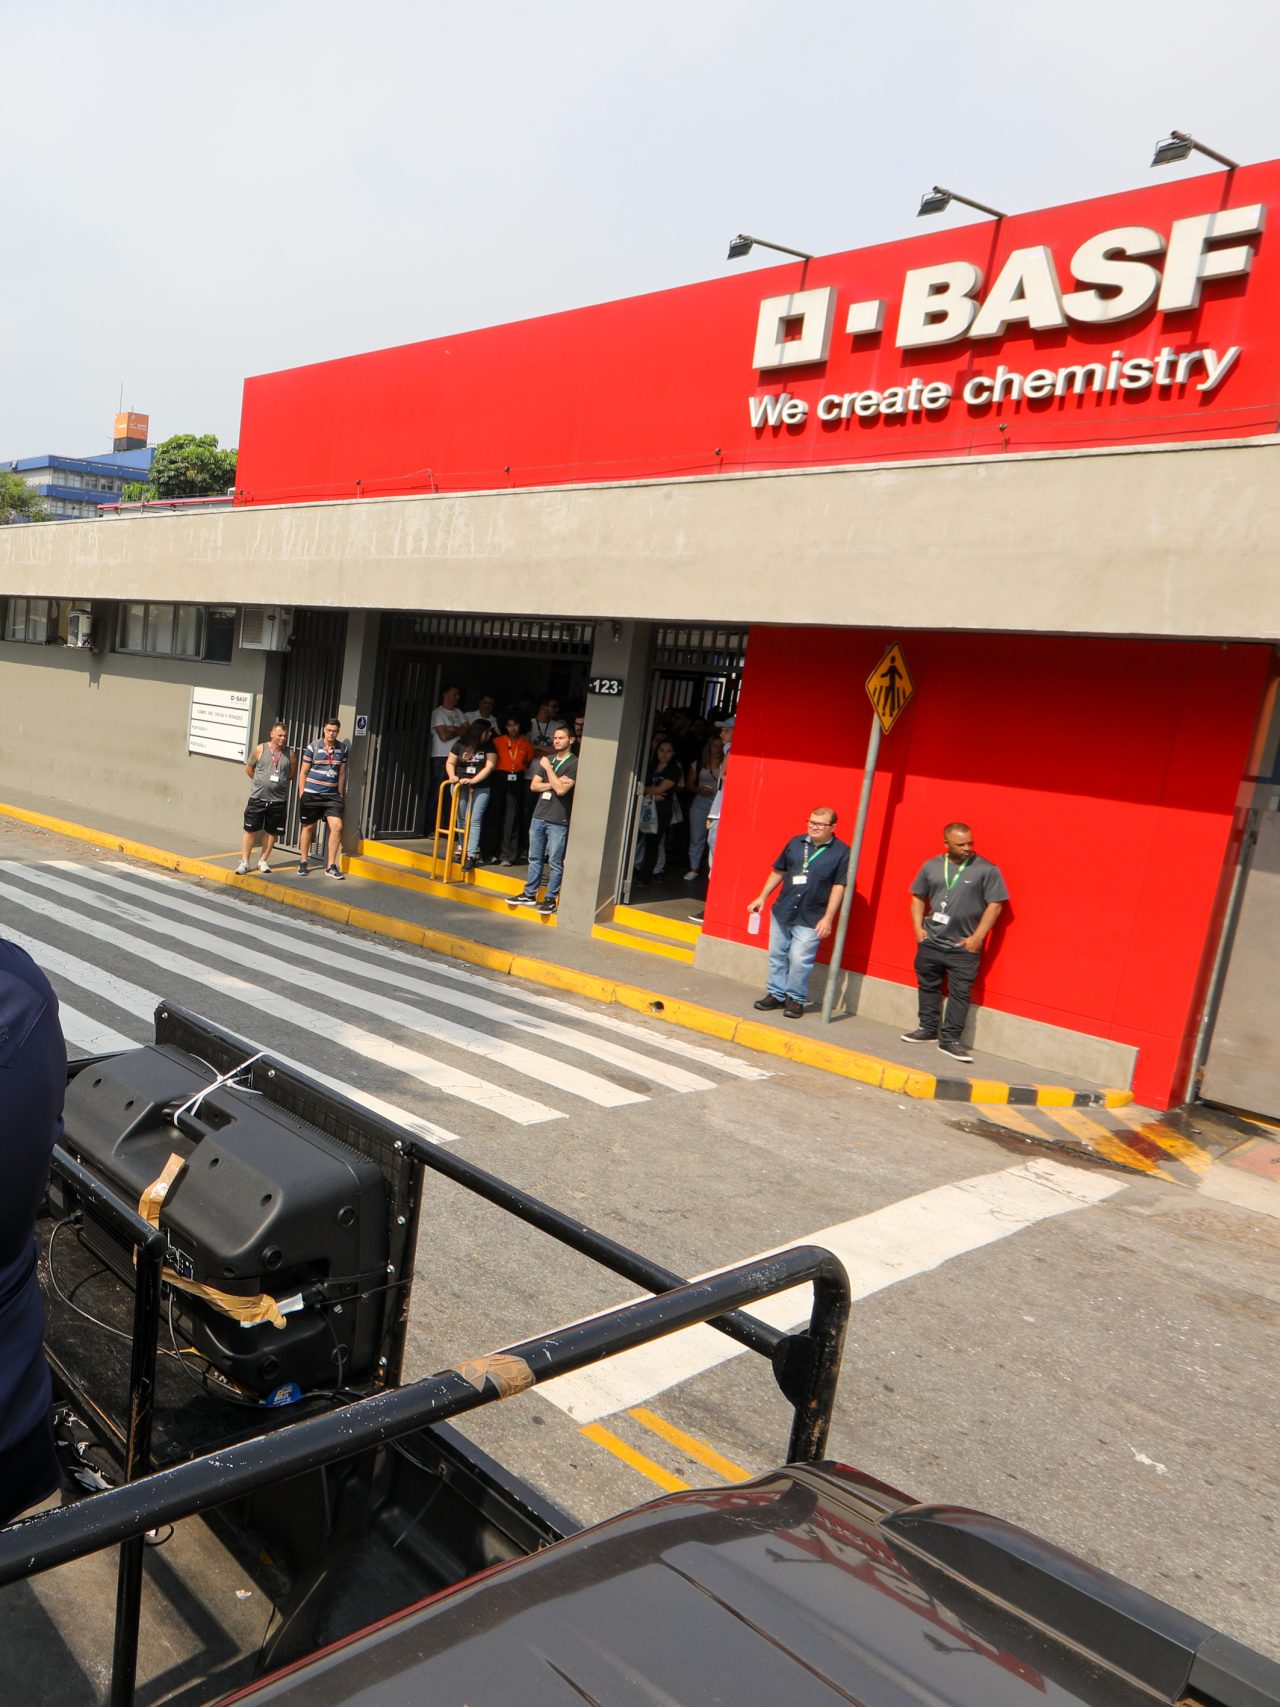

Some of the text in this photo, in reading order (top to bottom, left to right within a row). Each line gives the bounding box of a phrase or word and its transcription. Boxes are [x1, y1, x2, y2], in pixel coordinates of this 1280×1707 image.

[895, 202, 1265, 350] BASF
[748, 346, 1240, 428] We create chemistry
[593, 679, 618, 694] 123
